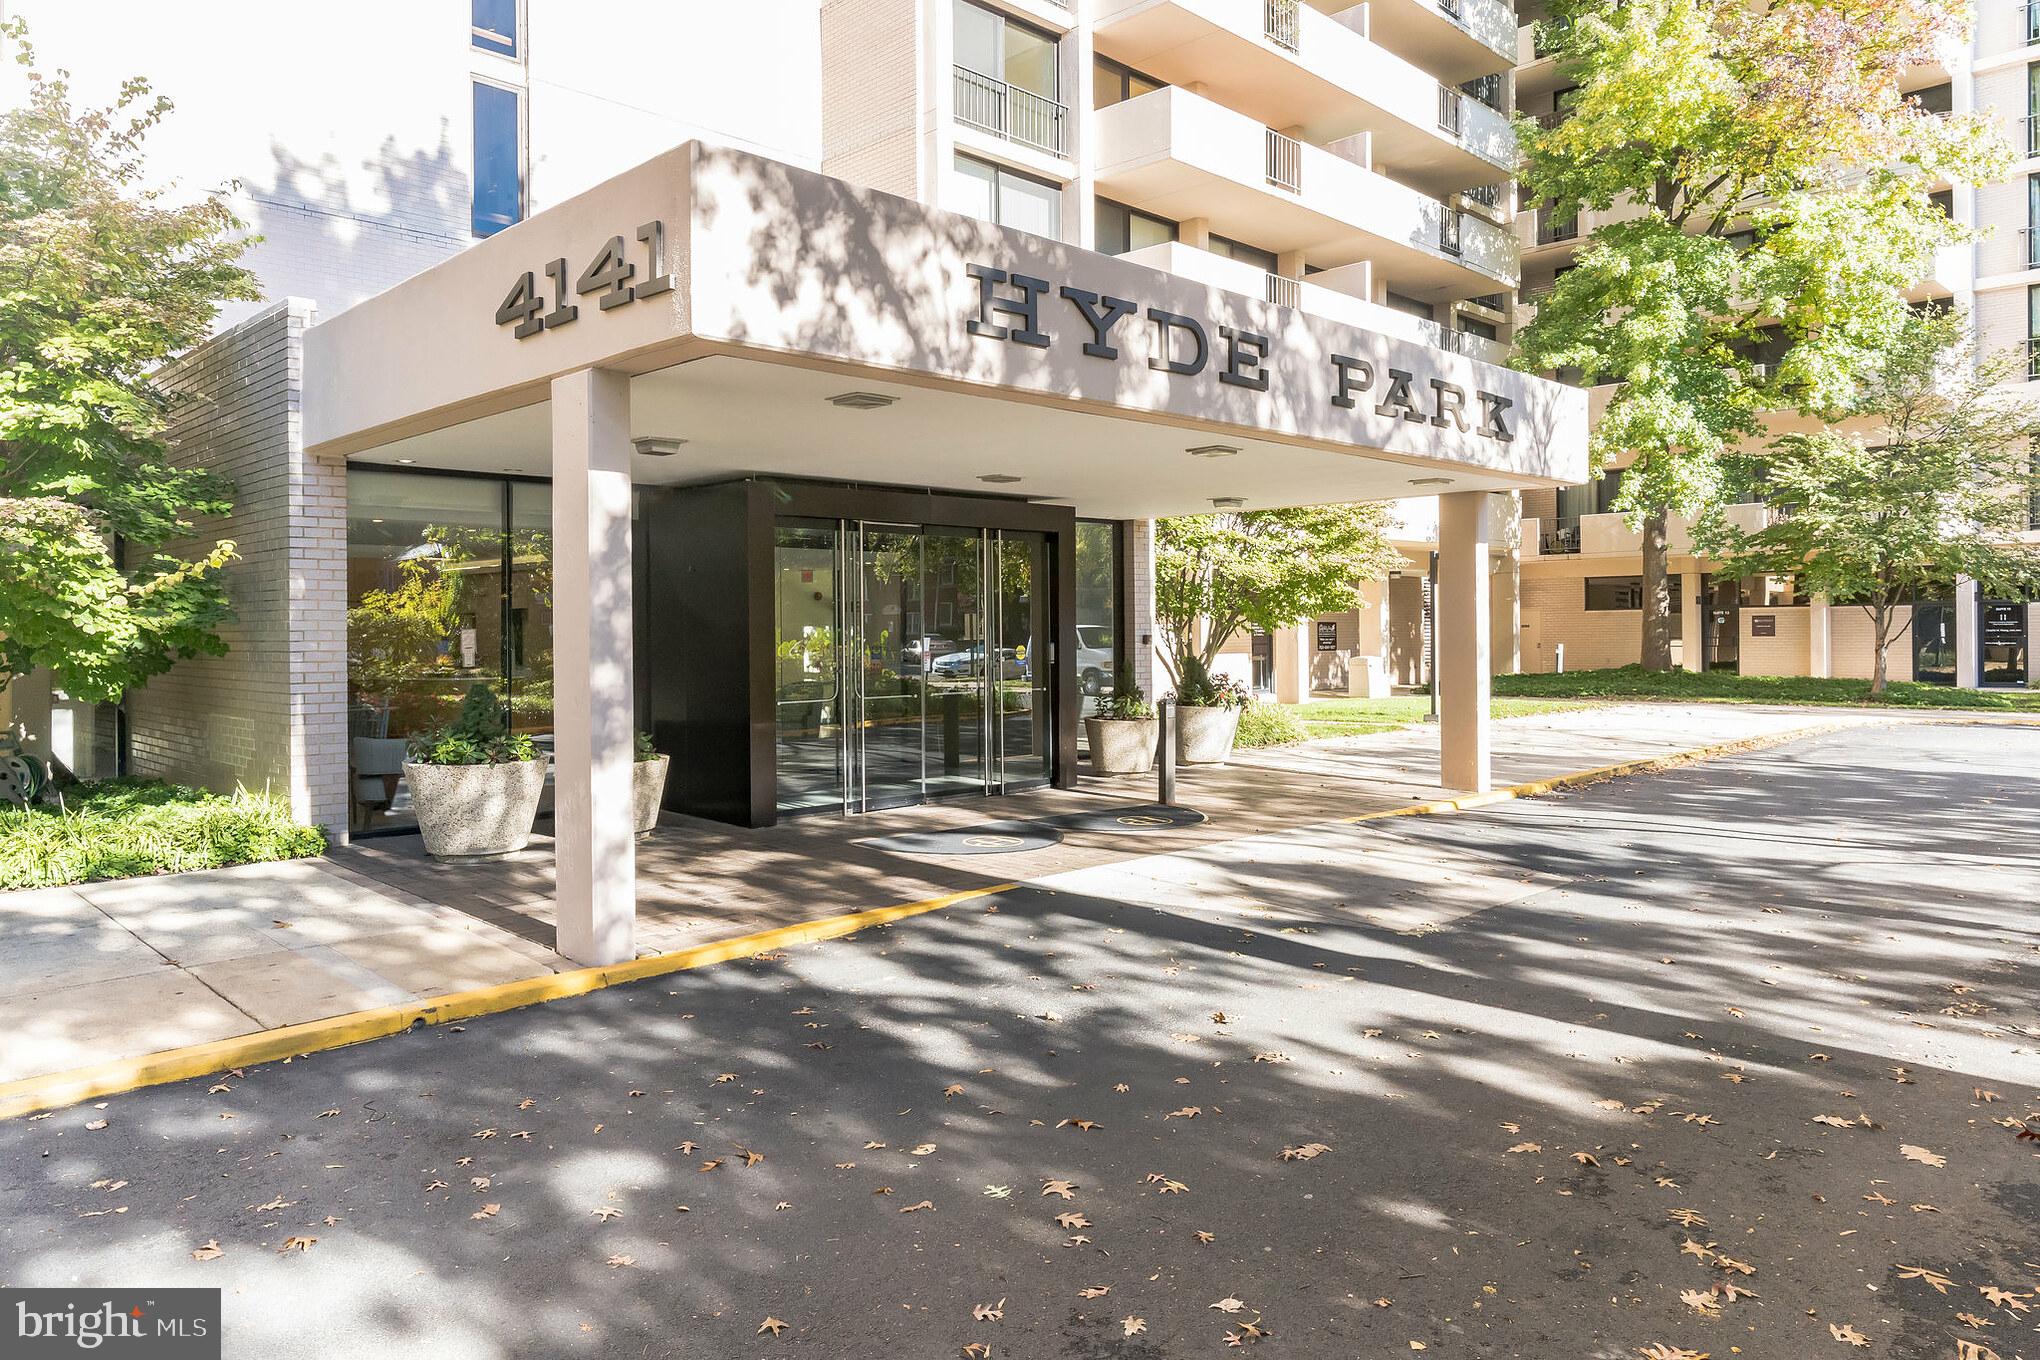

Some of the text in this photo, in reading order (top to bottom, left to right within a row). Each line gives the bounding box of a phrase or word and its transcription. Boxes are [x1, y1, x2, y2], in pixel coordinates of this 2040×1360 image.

[495, 219, 675, 340] 4141
[966, 263, 1513, 441] HYDE PARK
